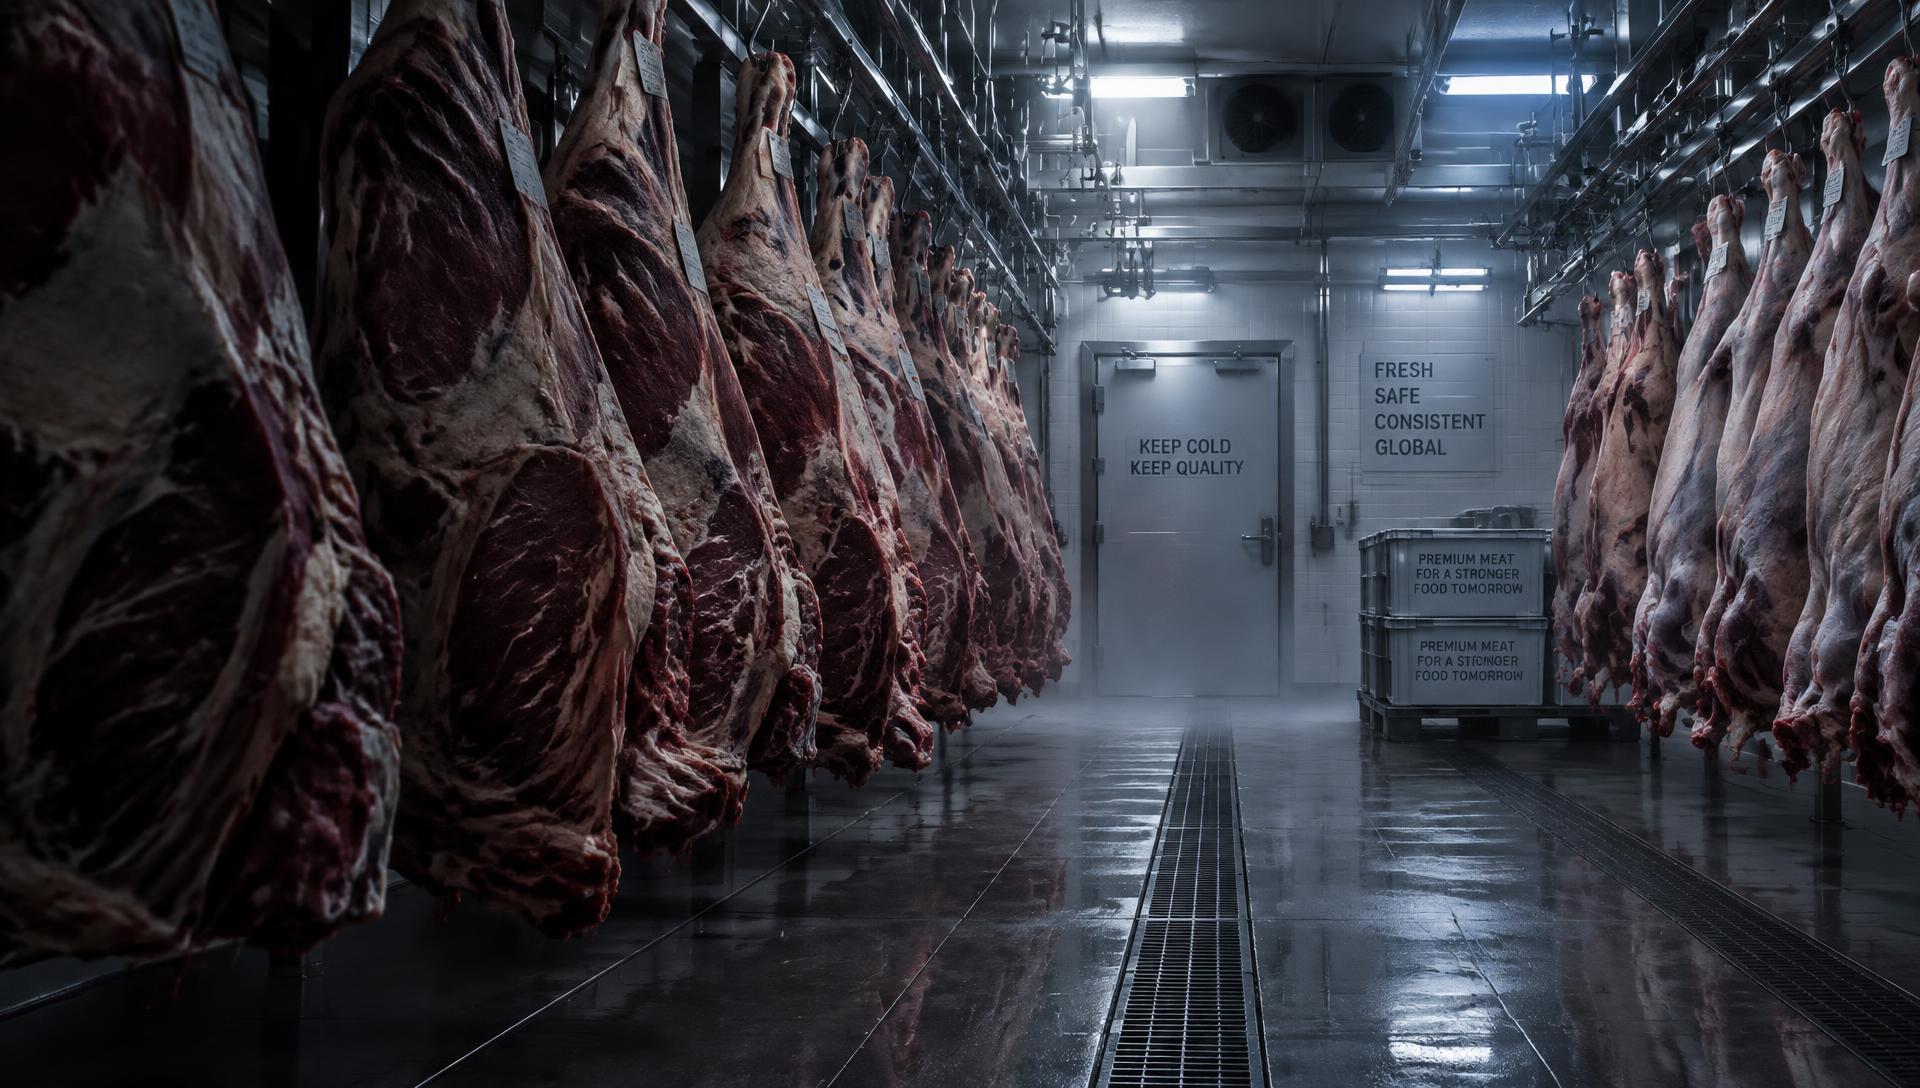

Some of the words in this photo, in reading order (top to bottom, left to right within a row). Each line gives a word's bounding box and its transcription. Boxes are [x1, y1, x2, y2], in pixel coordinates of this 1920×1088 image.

[1375, 362, 1433, 378] FRESH
[1375, 388, 1420, 404] SAFE
[1375, 413, 1485, 430] CONSISTENT
[1140, 439, 1182, 454] KEEP
[1187, 439, 1231, 454] COLD
[1375, 439, 1446, 456] GLOBAL
[1131, 460, 1171, 475] KEEP
[1176, 460, 1244, 476] QUALITY
[1419, 554, 1475, 565] PREMIUM
[1480, 554, 1515, 565] MEAT
[1417, 568, 1439, 579] FOR
[1444, 568, 1451, 579] A
[1455, 568, 1519, 579] STRONGER
[1415, 583, 1447, 594] FOOD
[1451, 583, 1523, 594] TOMORROW
[1420, 641, 1477, 652] PREMIUM
[1481, 641, 1515, 652] MEAT
[1418, 656, 1441, 666] FOR
[1445, 656, 1453, 666] A
[1415, 671, 1448, 681] FOOD
[1452, 671, 1523, 681] TOMORROW
